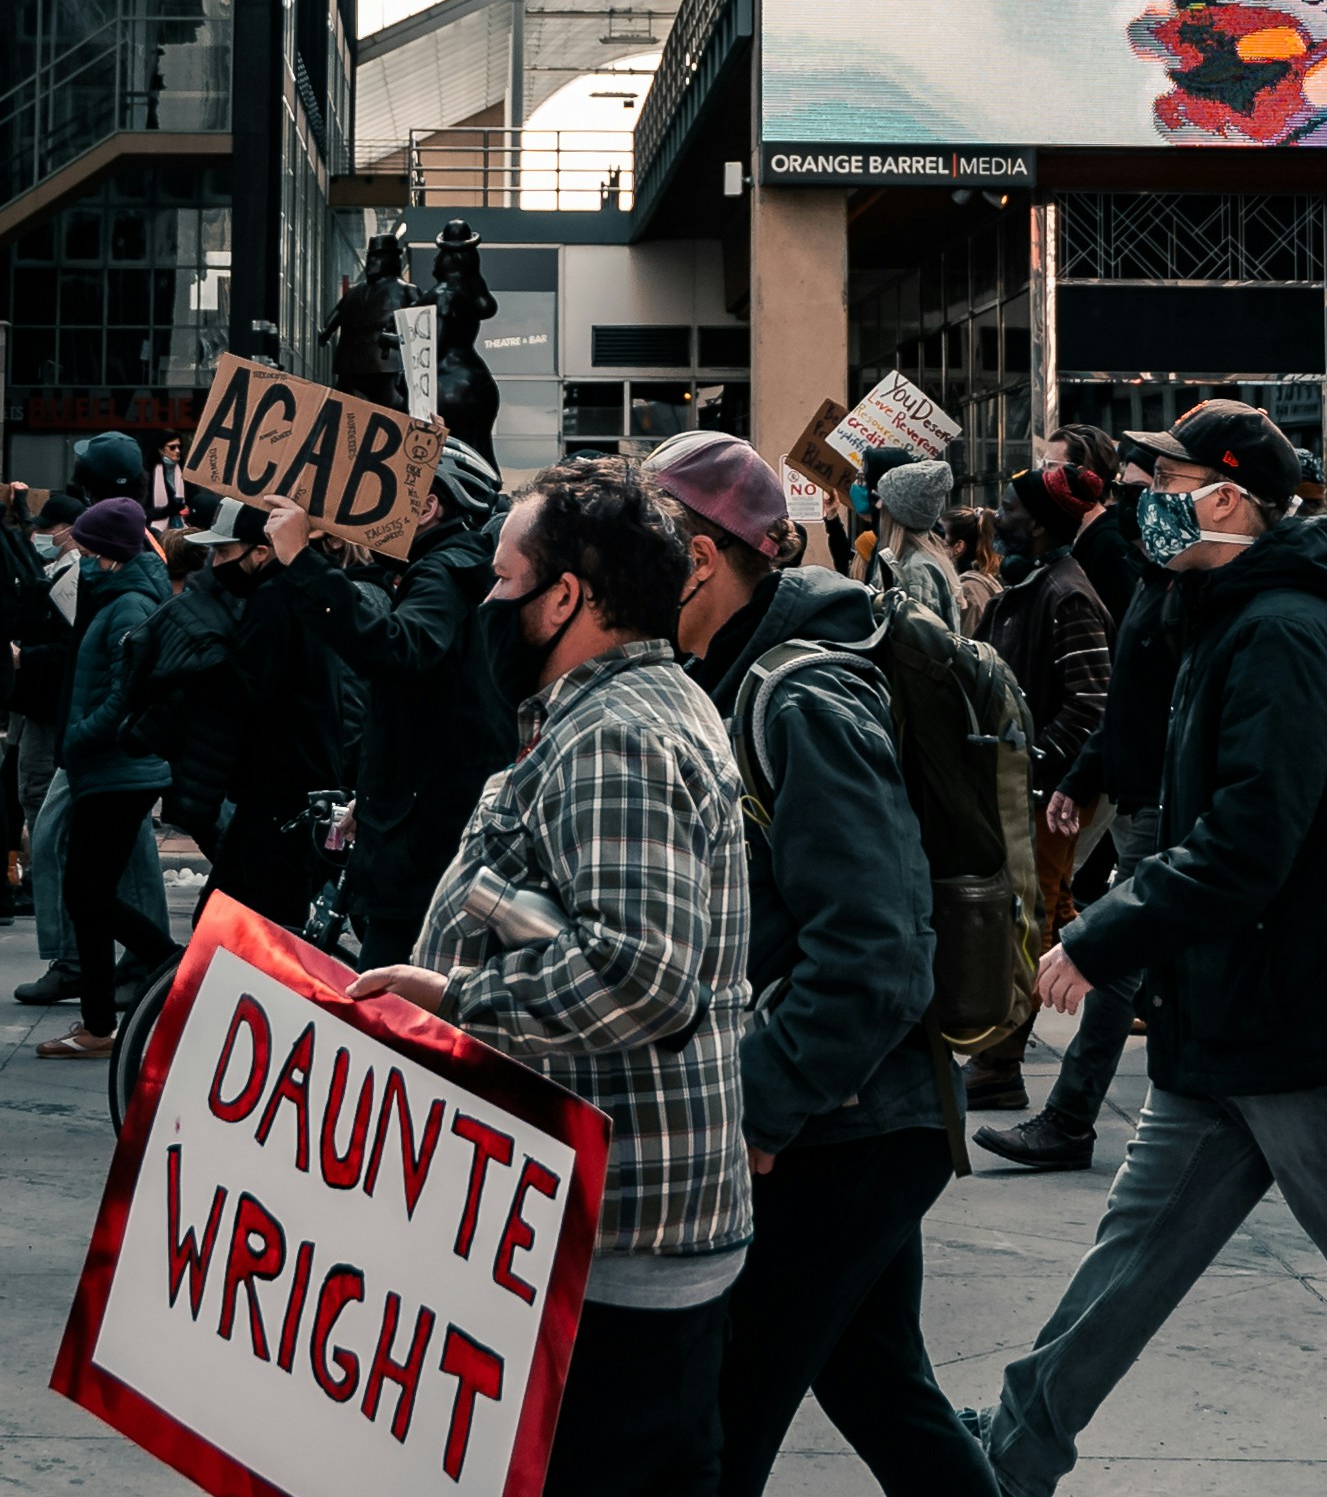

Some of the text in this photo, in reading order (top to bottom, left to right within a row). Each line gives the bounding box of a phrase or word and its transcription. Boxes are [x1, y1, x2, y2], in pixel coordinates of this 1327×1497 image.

[771, 154, 1029, 176] ORANGE BARREL MEDIA
[484, 336, 521, 350] THEATRE
[528, 334, 548, 345] BAR
[867, 388, 894, 418] Love
[186, 365, 403, 526] ACAB
[847, 417, 886, 448] credit
[790, 483, 817, 496] NO
[207, 990, 561, 1306] DAUNTE
[166, 1144, 506, 1483] WRIGHT
